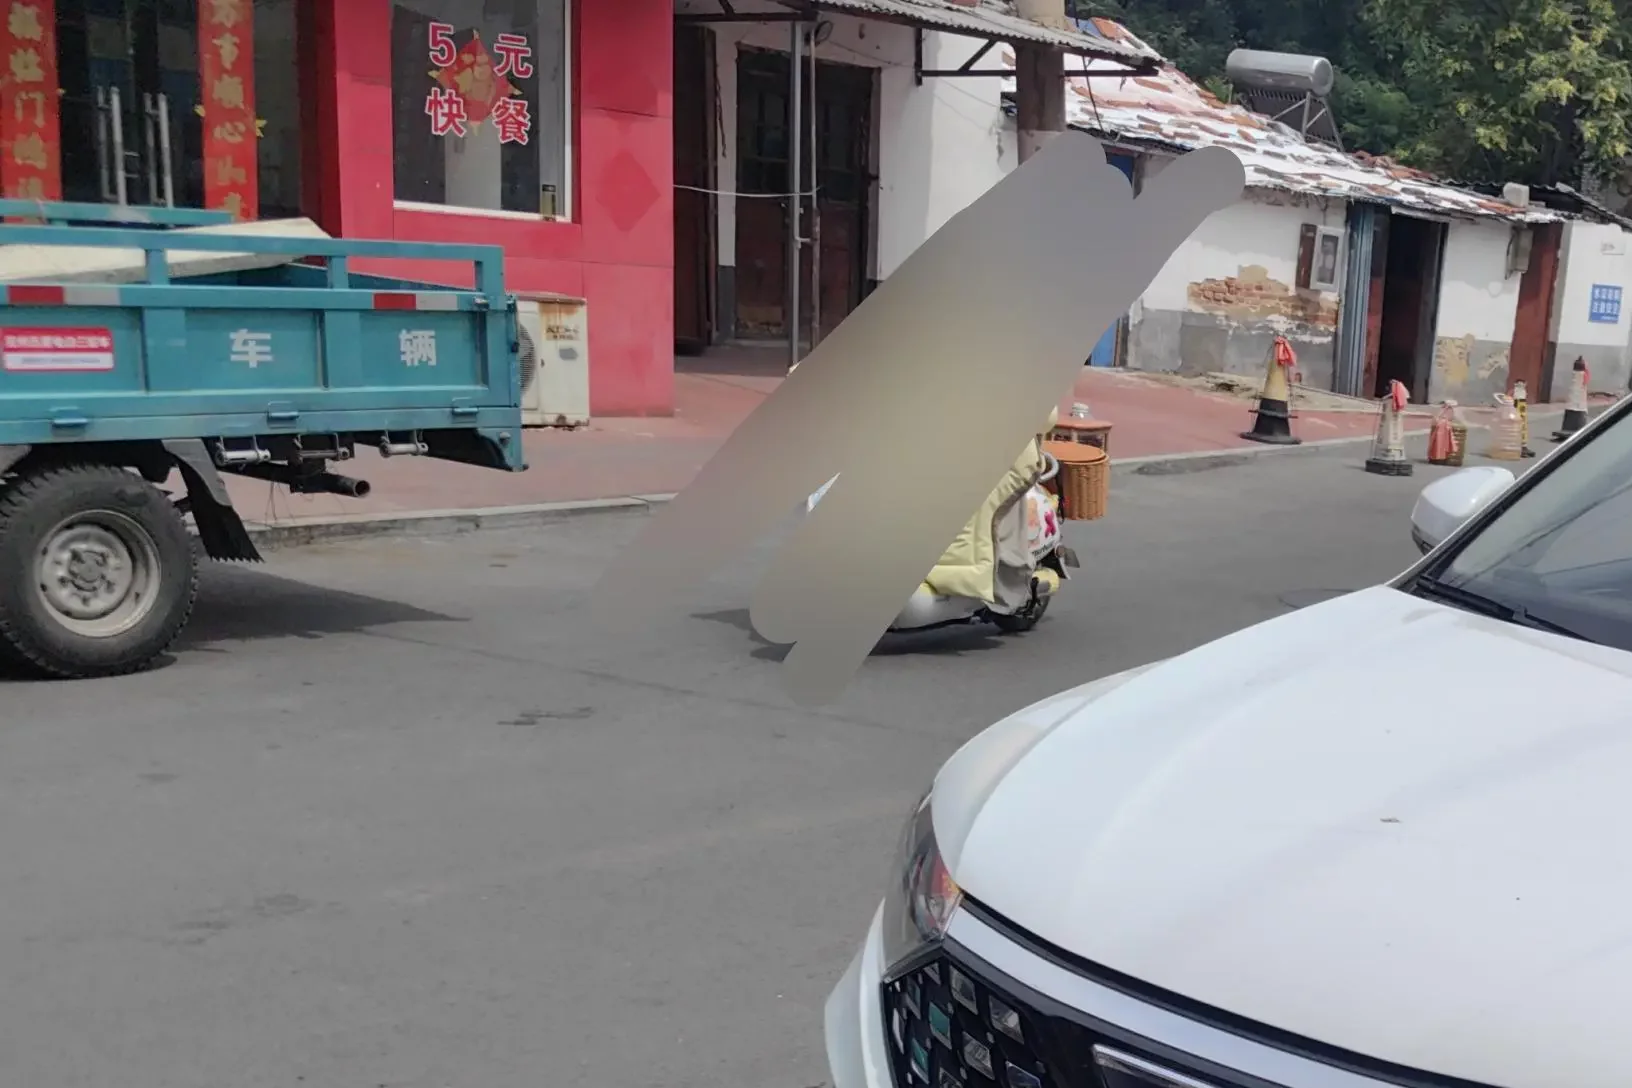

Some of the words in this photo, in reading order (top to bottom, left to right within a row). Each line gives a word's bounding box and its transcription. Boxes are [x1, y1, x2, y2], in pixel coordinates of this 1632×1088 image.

[425, 86, 532, 146] 快餐
[230, 328, 273, 369] 车
[399, 328, 437, 367] 辆
